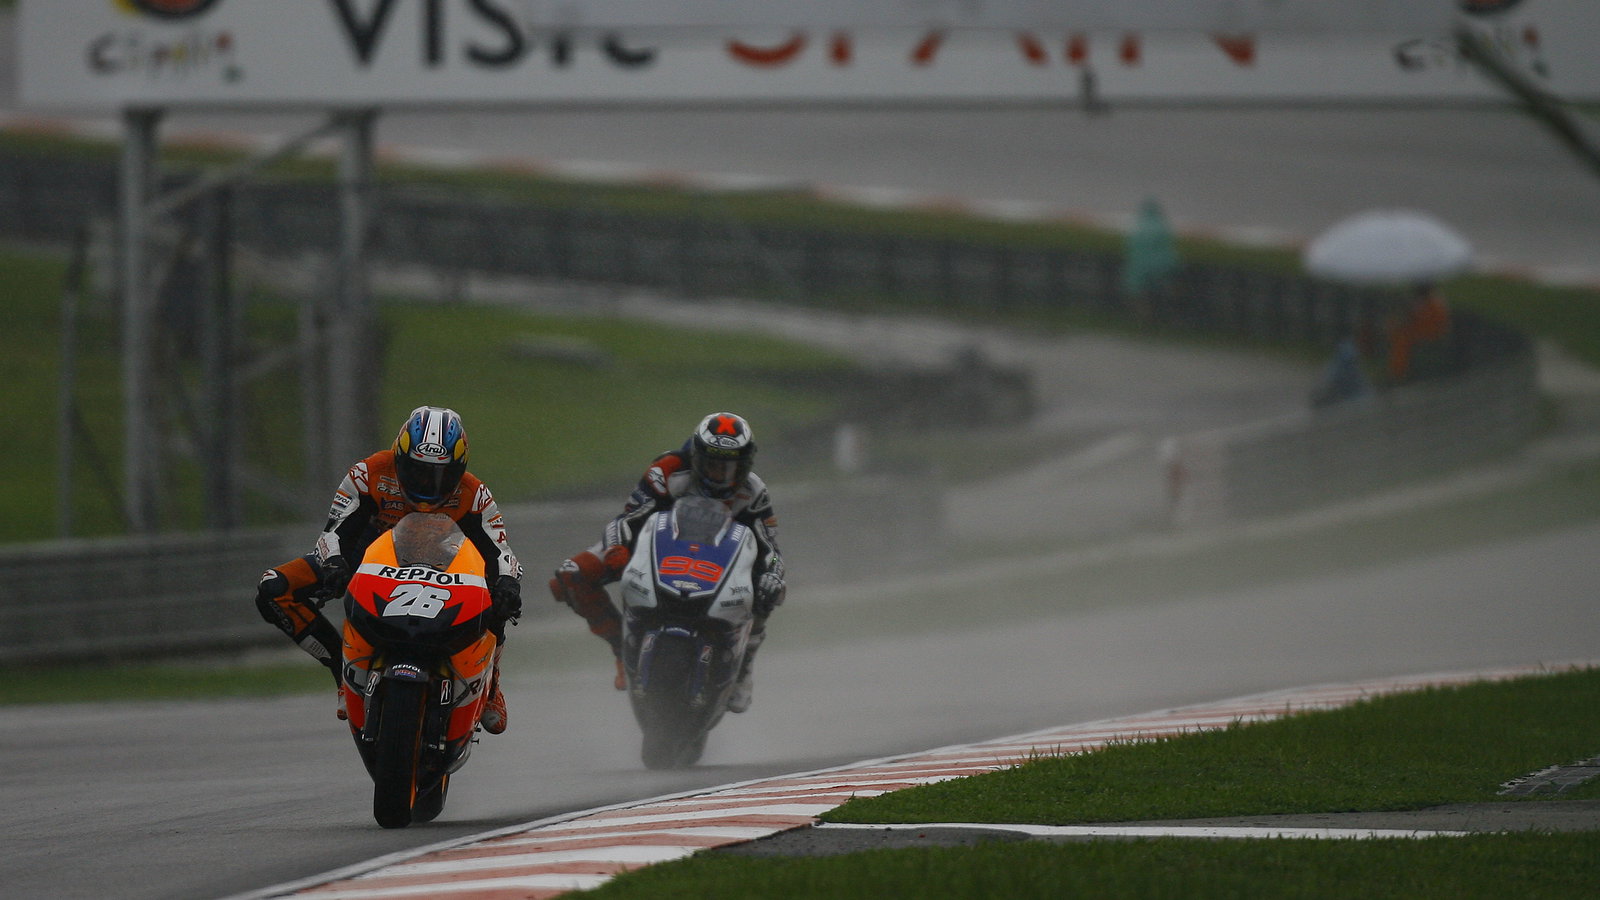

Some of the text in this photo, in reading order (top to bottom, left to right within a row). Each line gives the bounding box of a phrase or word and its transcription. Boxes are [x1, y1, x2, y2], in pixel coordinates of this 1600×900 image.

[418, 443, 444, 454] Arai
[378, 566, 465, 585] REPSOL
[658, 556, 724, 583] 99
[382, 583, 452, 619] 26
